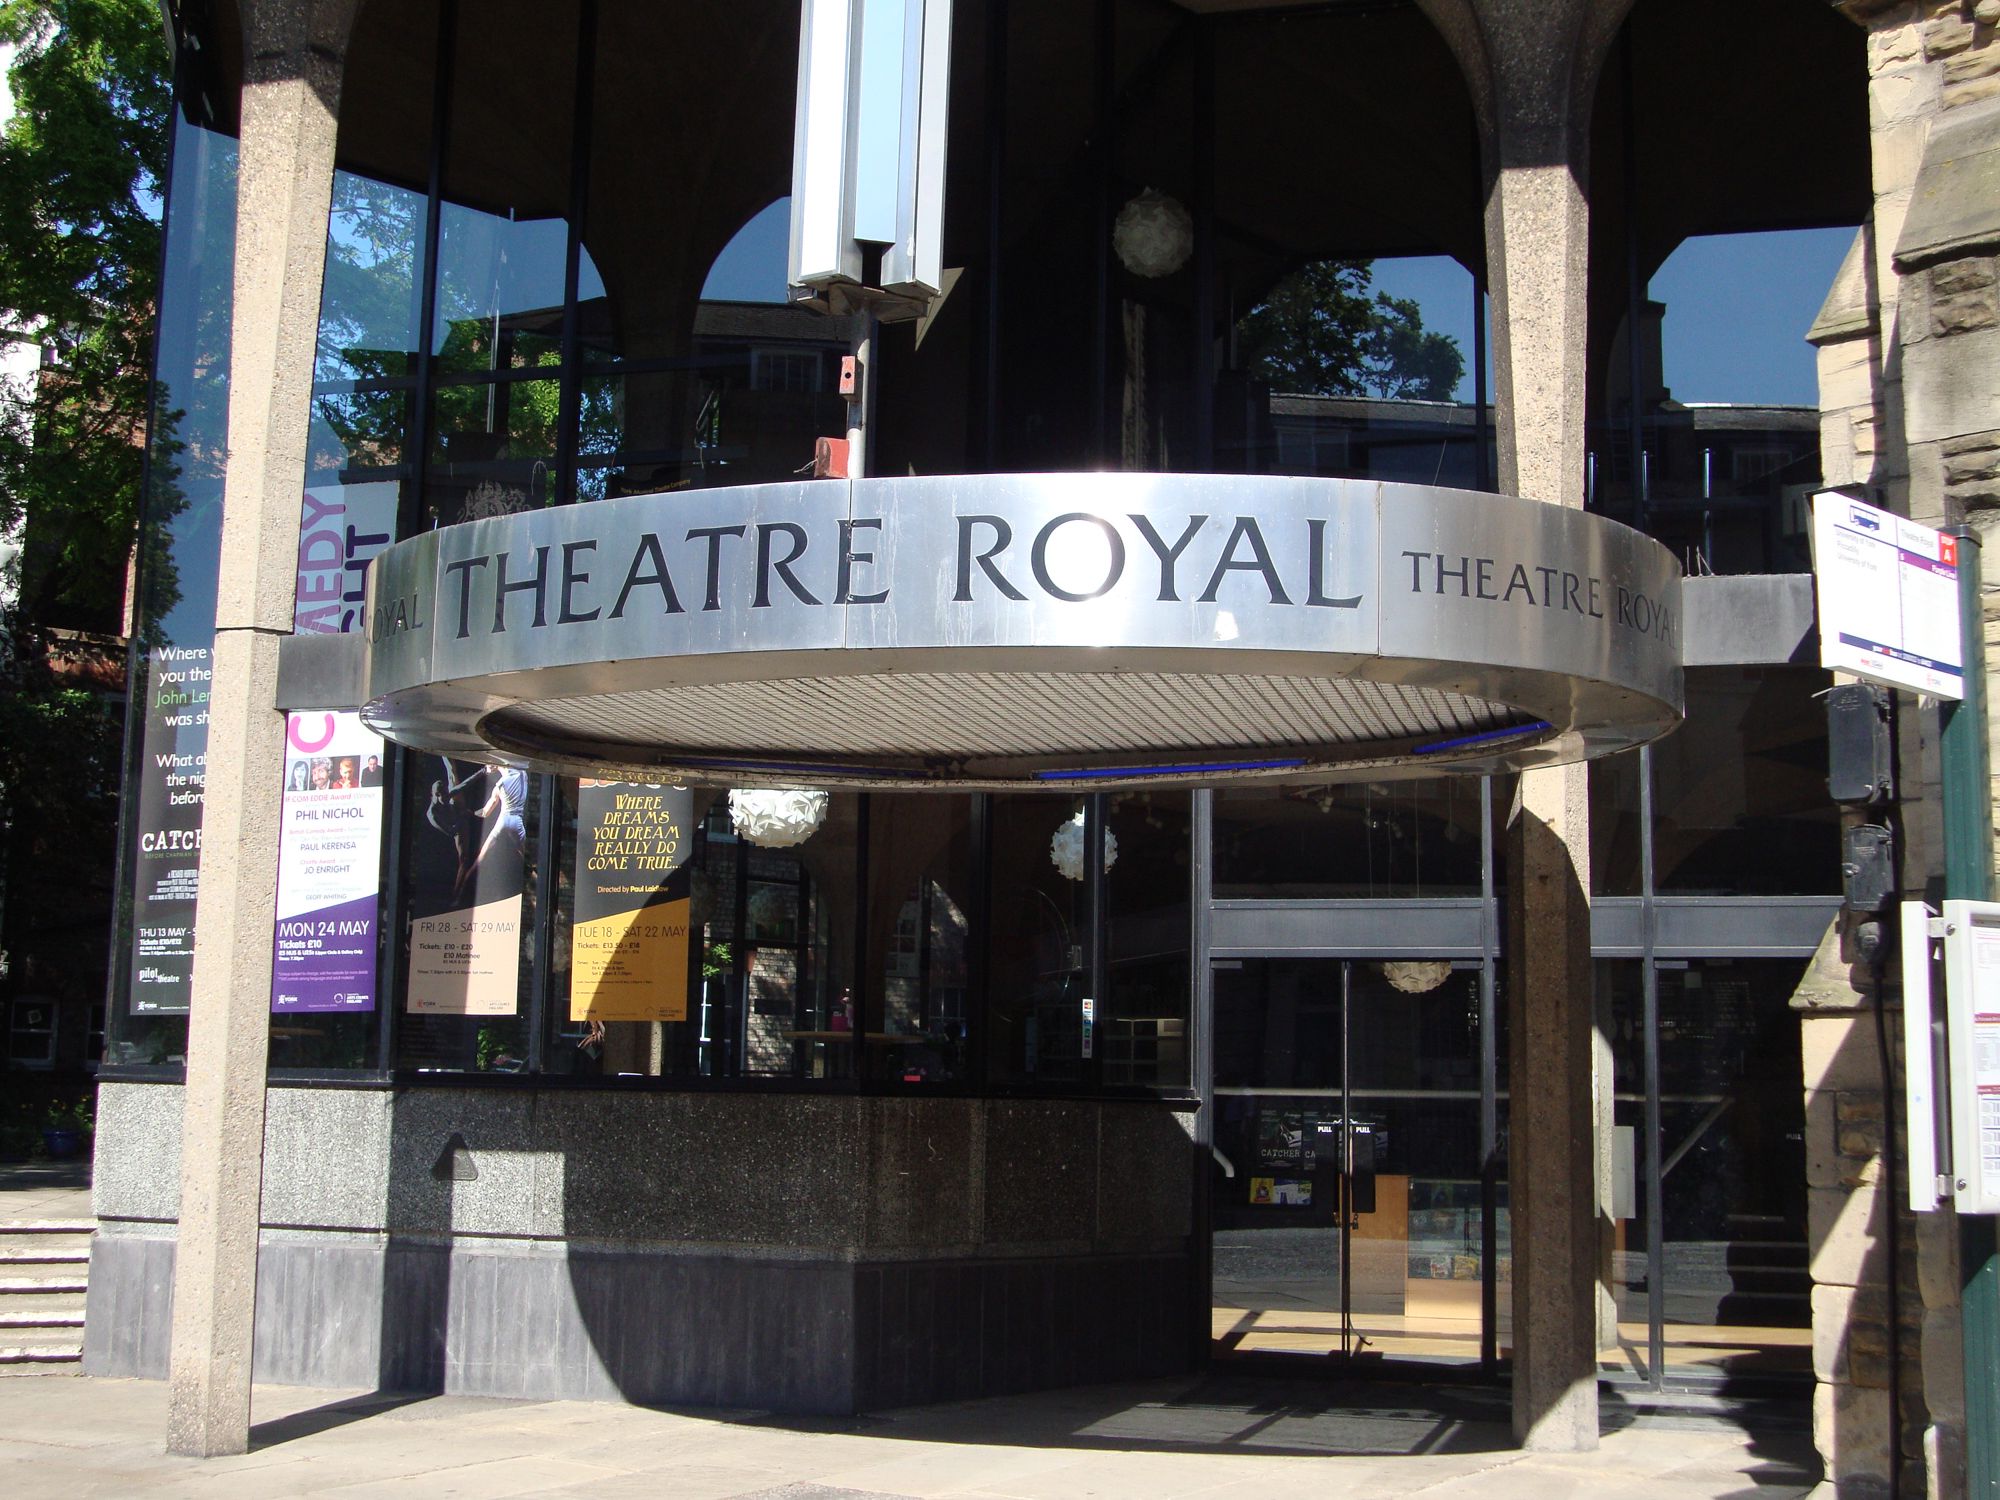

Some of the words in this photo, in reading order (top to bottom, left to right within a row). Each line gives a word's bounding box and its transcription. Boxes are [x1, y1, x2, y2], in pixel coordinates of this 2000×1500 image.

[1944, 549, 1951, 561] A
[445, 517, 890, 640] THEATRE
[953, 512, 1363, 610] ROYAL
[1401, 551, 1603, 619] THEATRE
[158, 647, 207, 661] Where
[159, 672, 185, 687] you
[189, 667, 211, 681] the
[155, 691, 187, 708] John
[165, 715, 192, 726] was
[196, 710, 210, 725] sh
[156, 754, 193, 768] What
[166, 773, 186, 787] the
[615, 793, 663, 810] WHERE
[295, 810, 319, 820] PHIL
[322, 807, 364, 819] NICHOL
[603, 811, 670, 826] DREAMS
[593, 827, 620, 840] YOU
[625, 825, 680, 841] DREAM
[300, 843, 319, 851] PAUL
[321, 841, 356, 850] KERENSA
[594, 841, 651, 856] REALLY
[656, 841, 676, 854] DO
[304, 866, 314, 874] JO
[316, 865, 350, 874] ENRIGHT
[587, 857, 629, 870] COME
[621, 886, 629, 894] by
[139, 928, 156, 937] THU
[158, 928, 166, 937] 13
[167, 928, 186, 936] MAY
[279, 922, 314, 937] MON
[318, 921, 335, 936] 24
[339, 920, 370, 936] MAY
[421, 922, 435, 932] FRI
[438, 922, 451, 932] 28
[460, 922, 478, 933] SAT
[481, 922, 493, 932] 29
[496, 922, 515, 933] MAY
[578, 927, 598, 938] TUE
[602, 927, 612, 938] 18
[623, 926, 642, 938] SAT
[645, 926, 657, 938] 22
[661, 926, 686, 937] MAY
[278, 940, 306, 949] Tickets
[307, 939, 322, 949] £10
[139, 967, 158, 981] pilot
[157, 974, 180, 983] theatre
[1355, 1126, 1371, 1134] PULL
[1260, 1148, 1300, 1158] CATCHER
